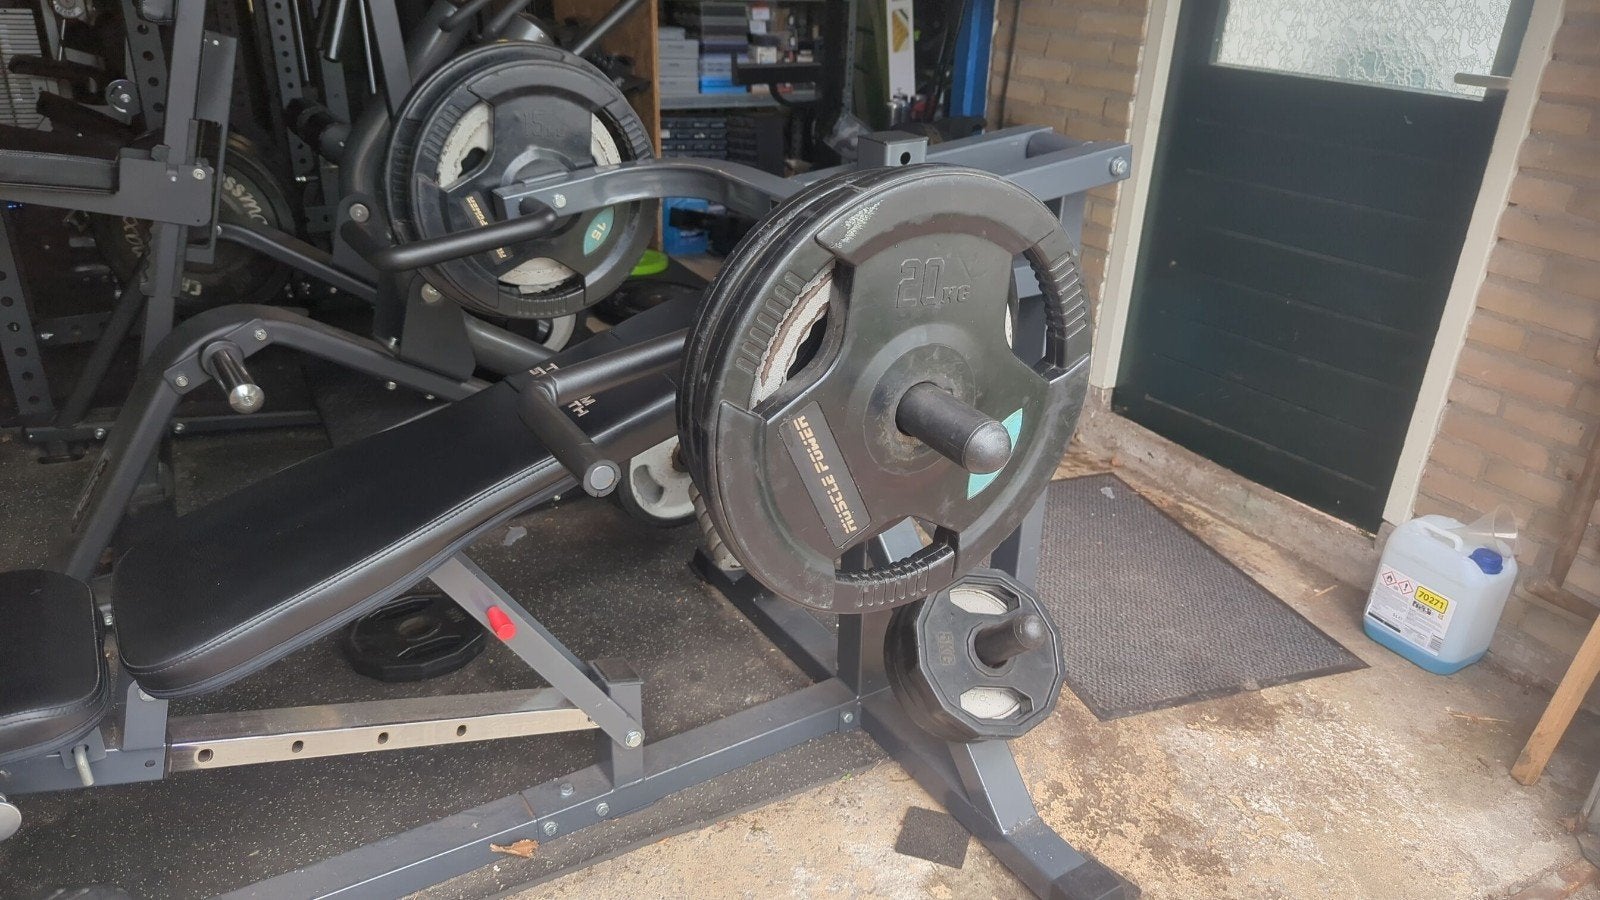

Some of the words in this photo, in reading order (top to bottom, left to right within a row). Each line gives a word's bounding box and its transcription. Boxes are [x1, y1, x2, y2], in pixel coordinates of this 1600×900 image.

[793, 415, 829, 473] POWER
[821, 474, 857, 534] MUSCLE
[1418, 590, 1444, 609] 70271
